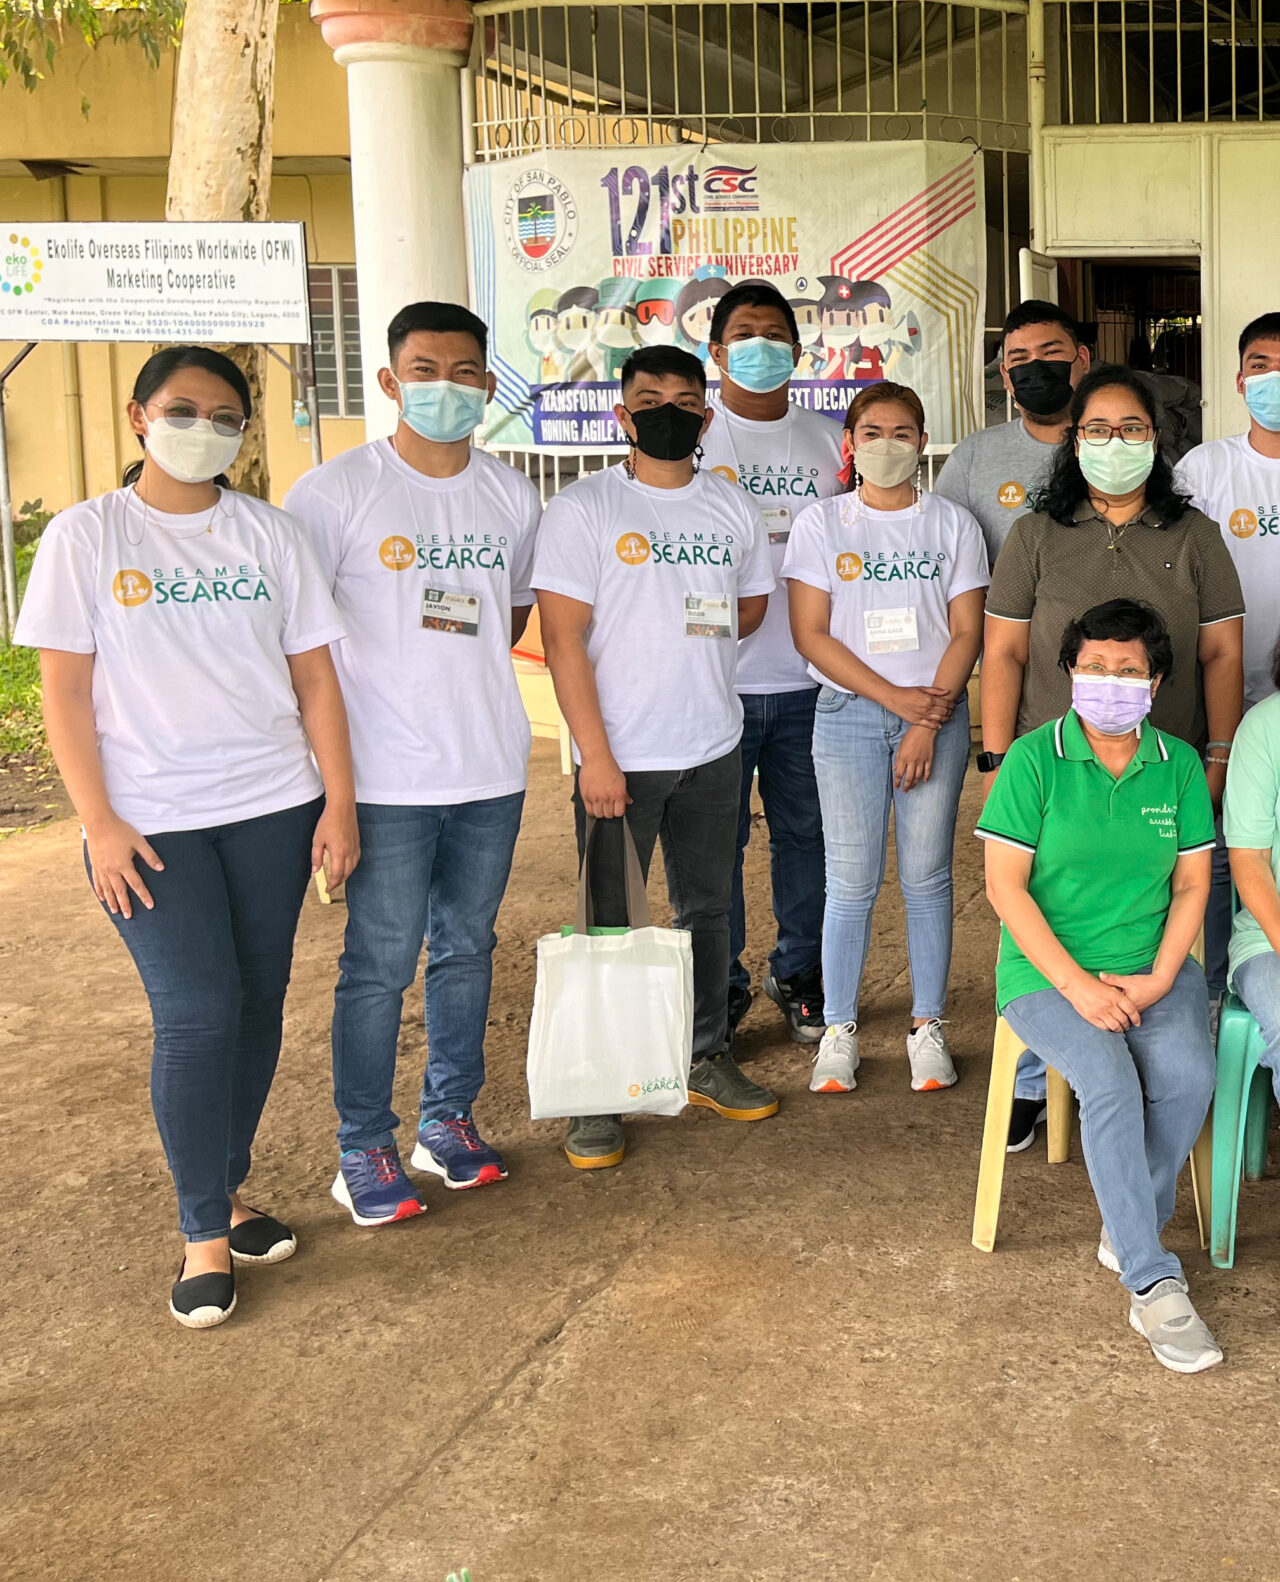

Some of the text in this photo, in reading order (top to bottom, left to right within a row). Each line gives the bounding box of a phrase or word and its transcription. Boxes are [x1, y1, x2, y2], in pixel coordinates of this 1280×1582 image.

[703, 176, 758, 193] CSC
[504, 171, 576, 225] CITY OF SAN PABLO
[601, 165, 700, 256] 121st
[672, 217, 799, 254] PHILIPPINE
[5, 251, 28, 265] eko
[47, 238, 295, 266] Ekolife Overseas Filipinos Worldwide (OFW)
[511, 244, 571, 272] OFFICIAL SEAL
[613, 256, 643, 278] CIVIL
[648, 255, 701, 277] SERVICE
[106, 268, 236, 294] Marketing Cooperative
[63, 318, 122, 327] Registration
[540, 388, 622, 413] TRANSFORMIN
[788, 386, 811, 410] EXT
[540, 419, 579, 442] HONING
[582, 419, 614, 442] AGILE
[738, 464, 820, 477] SEAMEO
[738, 475, 819, 498] SEARCA
[416, 534, 508, 546] SEAMEO
[650, 531, 734, 544] SEAMEO
[417, 547, 506, 571] SEARCA
[651, 543, 733, 567] SEARCA
[863, 551, 946, 561] SEAMEO
[863, 560, 941, 581] SEARCA
[154, 579, 272, 604] SEARCA
[642, 1082, 680, 1096] SEARCA
